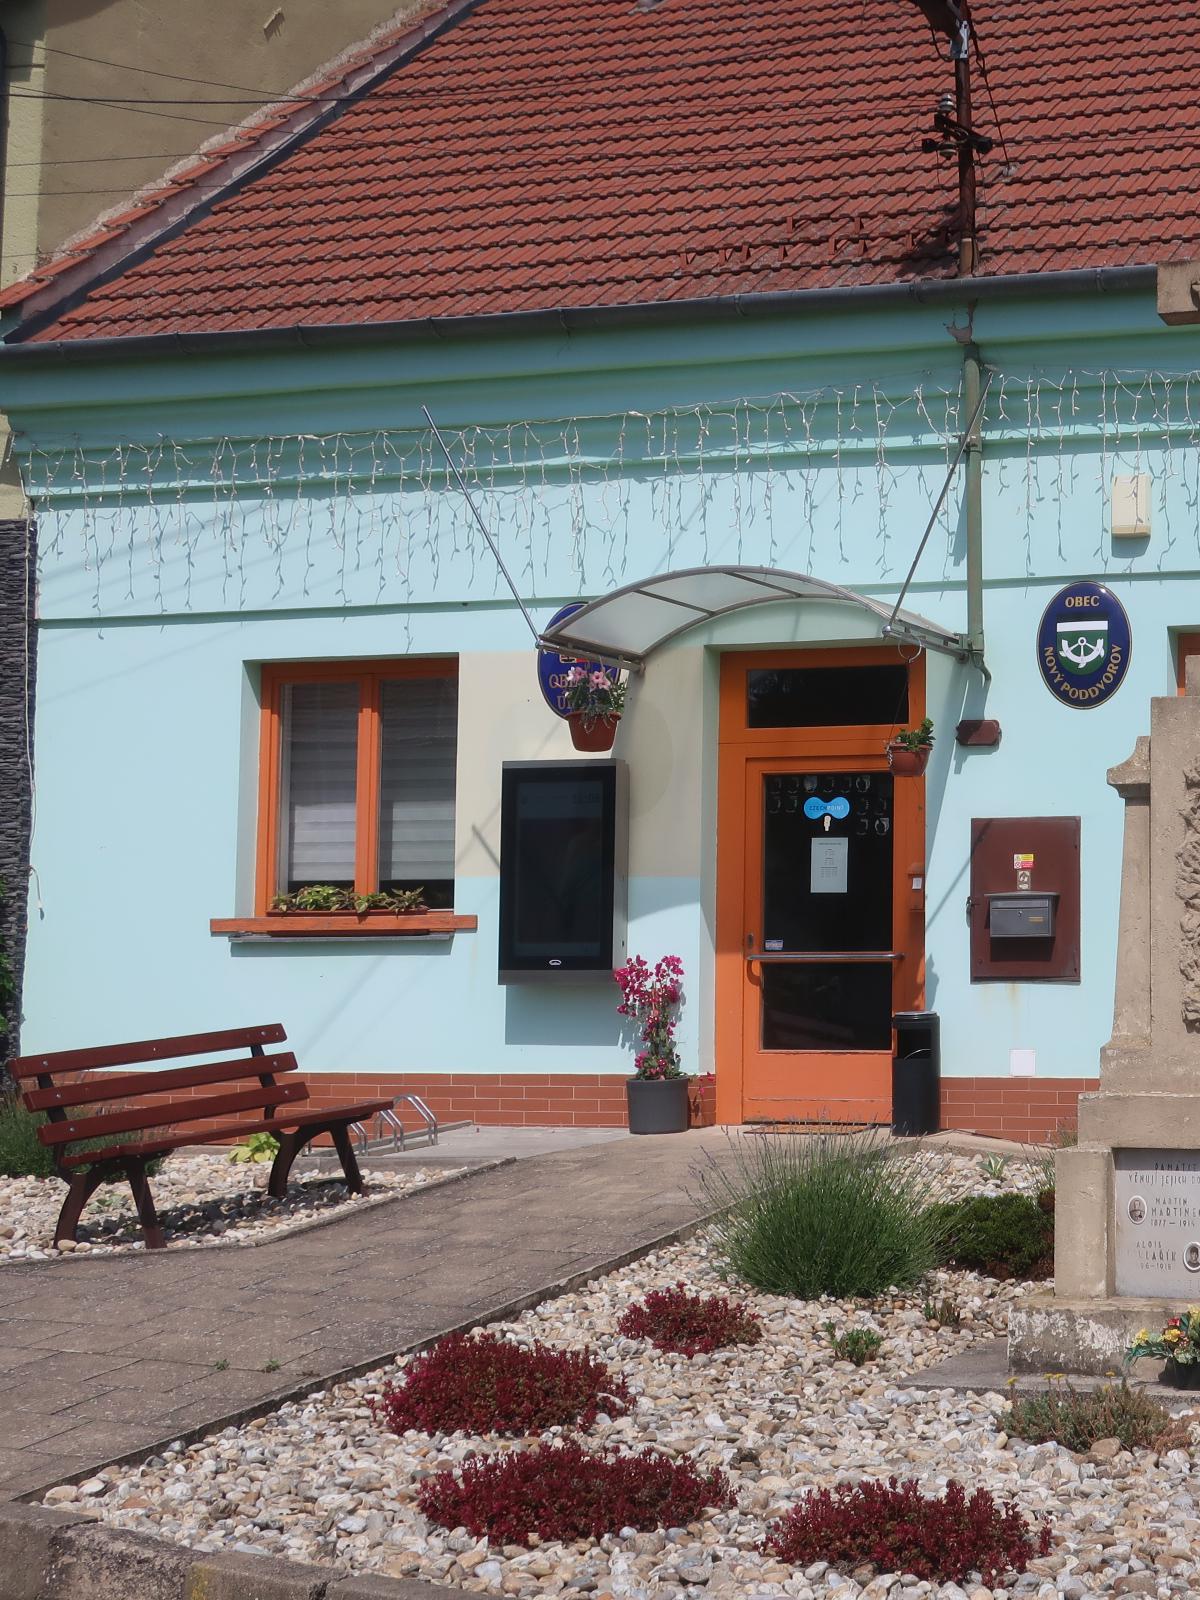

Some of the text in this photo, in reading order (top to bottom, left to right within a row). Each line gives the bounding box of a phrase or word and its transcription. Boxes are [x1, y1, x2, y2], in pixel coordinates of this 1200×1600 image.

[1065, 595, 1100, 608] OBEC
[1044, 644, 1122, 700] NOVÝ PODDVOROV
[1155, 1197, 1188, 1206] MARTIN
